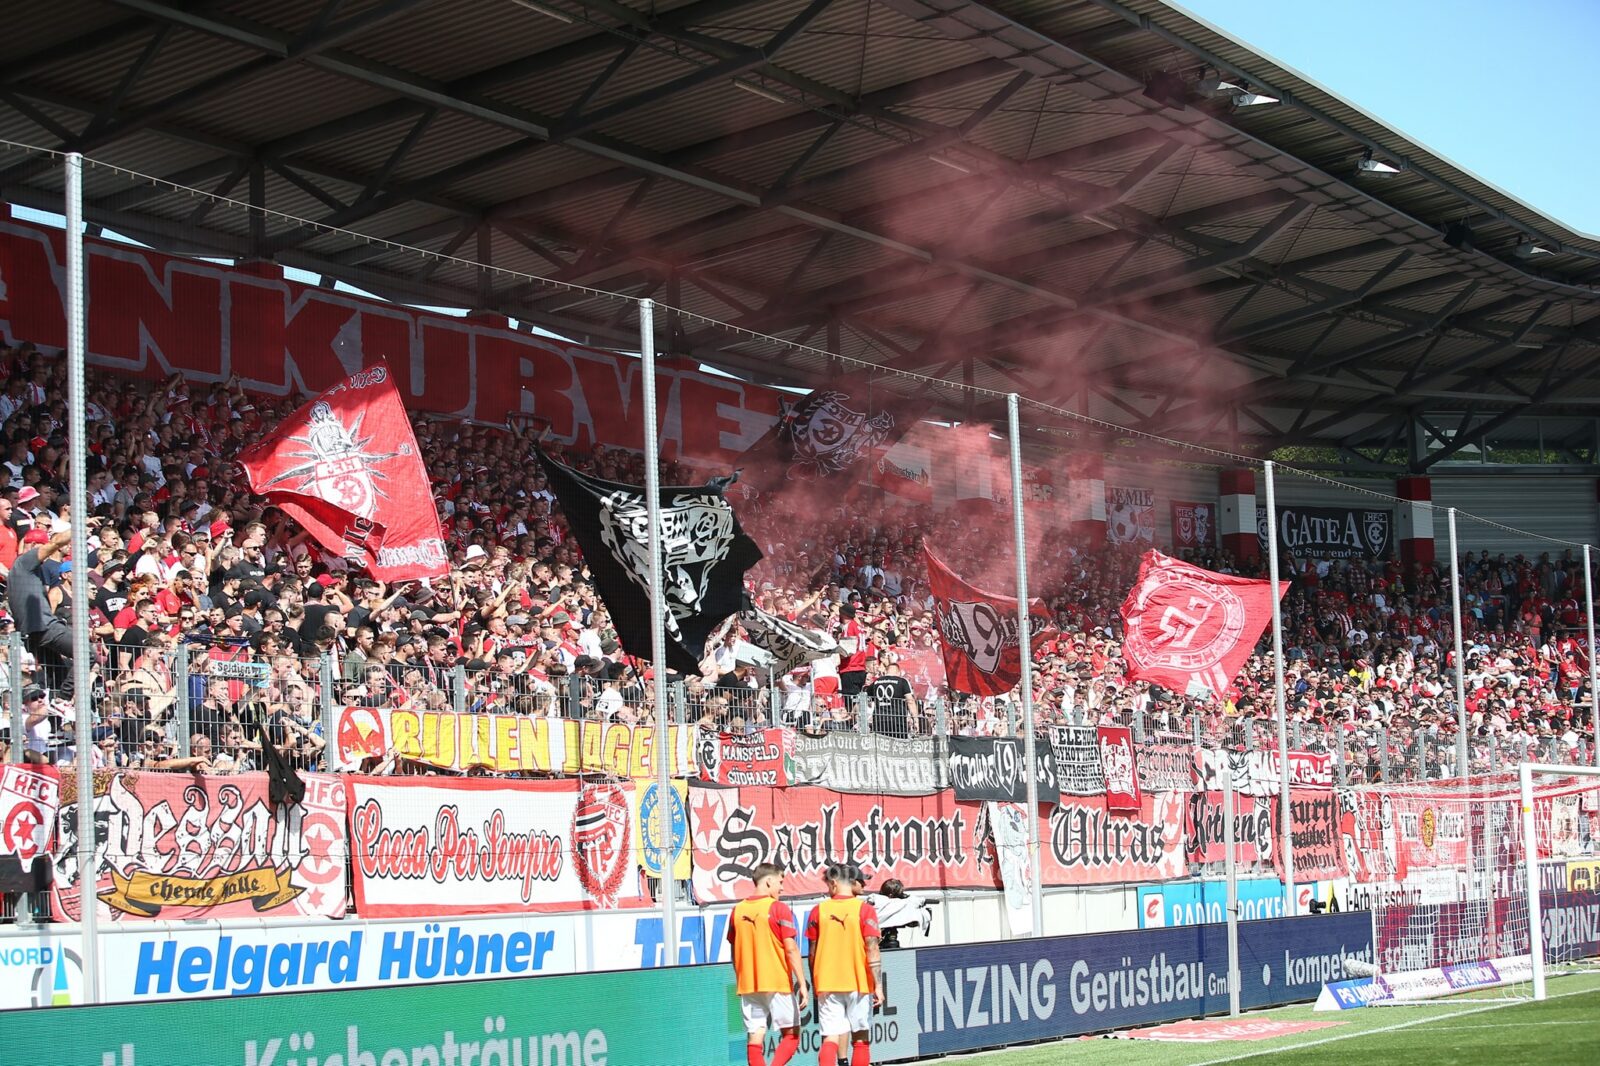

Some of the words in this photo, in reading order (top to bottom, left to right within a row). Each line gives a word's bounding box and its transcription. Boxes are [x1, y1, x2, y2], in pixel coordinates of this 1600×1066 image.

[1177, 508, 1193, 518] HFC
[1367, 513, 1384, 521] HFC
[1281, 510, 1341, 547] GATE
[1343, 511, 1364, 549] A
[1304, 547, 1364, 558] Surender
[390, 709, 551, 773] BULLEN
[722, 743, 780, 762] MANSFELD
[14, 774, 50, 801] HFC
[727, 765, 777, 786] SÜDHARZ
[305, 780, 346, 807] HFC
[1051, 806, 1166, 867] Ultras
[1186, 793, 1257, 855] Köten
[431, 804, 479, 883] Per
[480, 808, 563, 903] Sempre
[715, 802, 966, 883] Saalefront
[1173, 901, 1222, 927] RADIO
[0, 946, 53, 966] NORD
[134, 930, 363, 996] Helgard
[379, 923, 556, 982] Hübner
[918, 958, 1057, 1034] INZING
[1070, 952, 1204, 1015] Gerüstbau
